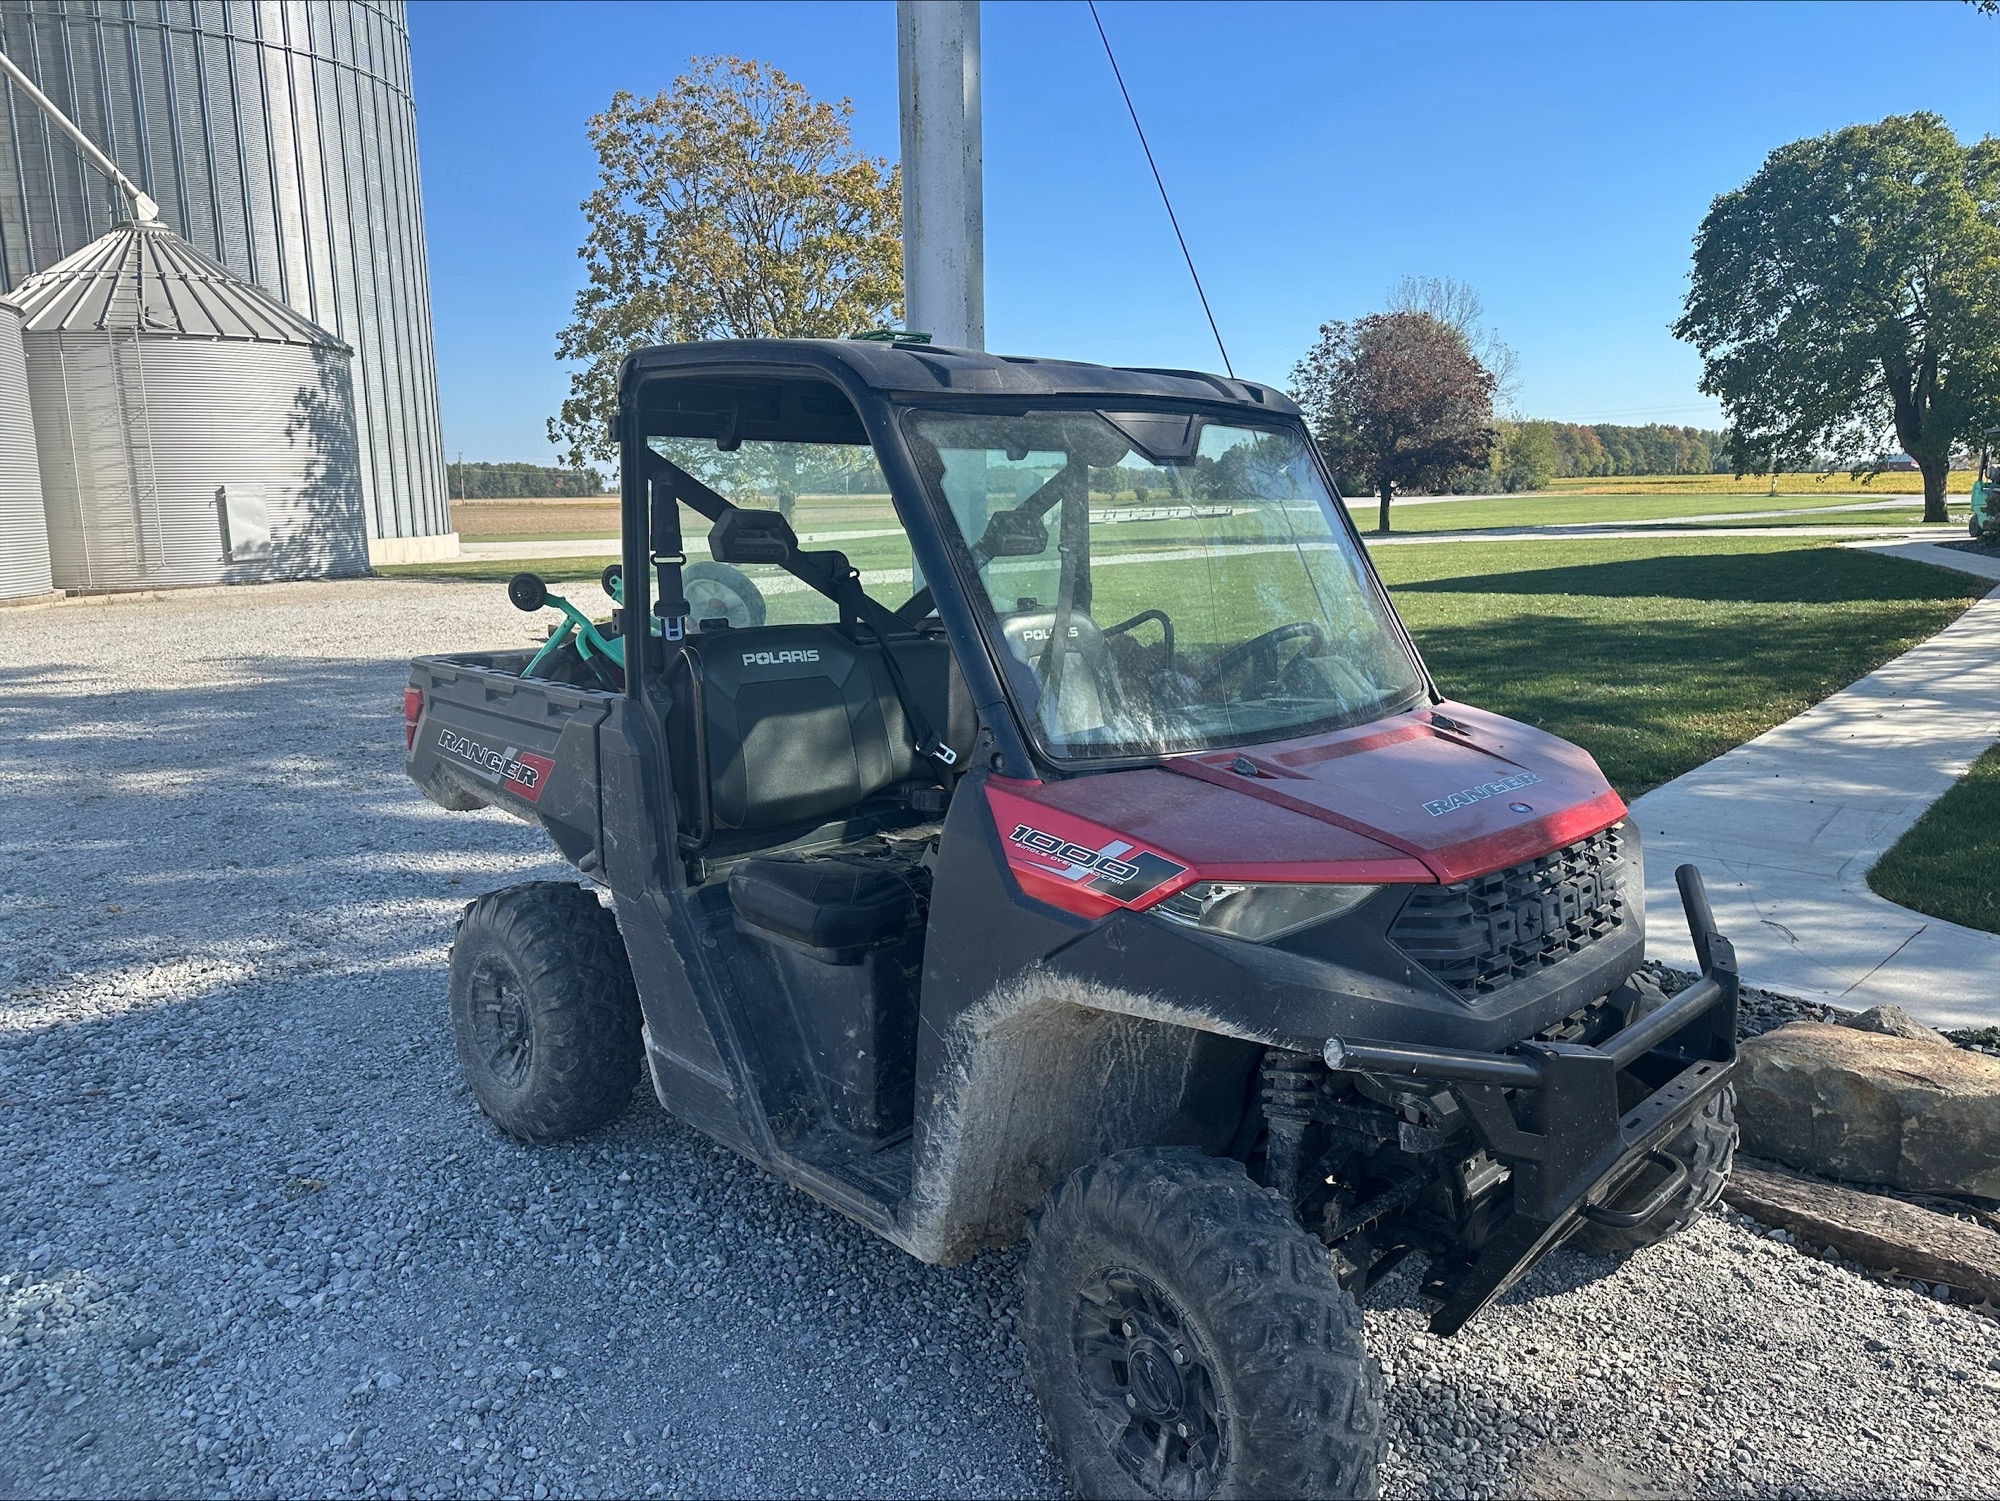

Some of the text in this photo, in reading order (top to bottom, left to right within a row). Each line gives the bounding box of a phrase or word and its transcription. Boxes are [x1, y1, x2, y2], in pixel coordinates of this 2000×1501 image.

[741, 649, 820, 666] POLARIS
[438, 728, 540, 789] RANGER
[1422, 772, 1543, 817] RANGER
[1009, 824, 1140, 881] 1000
[1101, 874, 1124, 886] CAM
[1488, 860, 1619, 954] POLARIS
